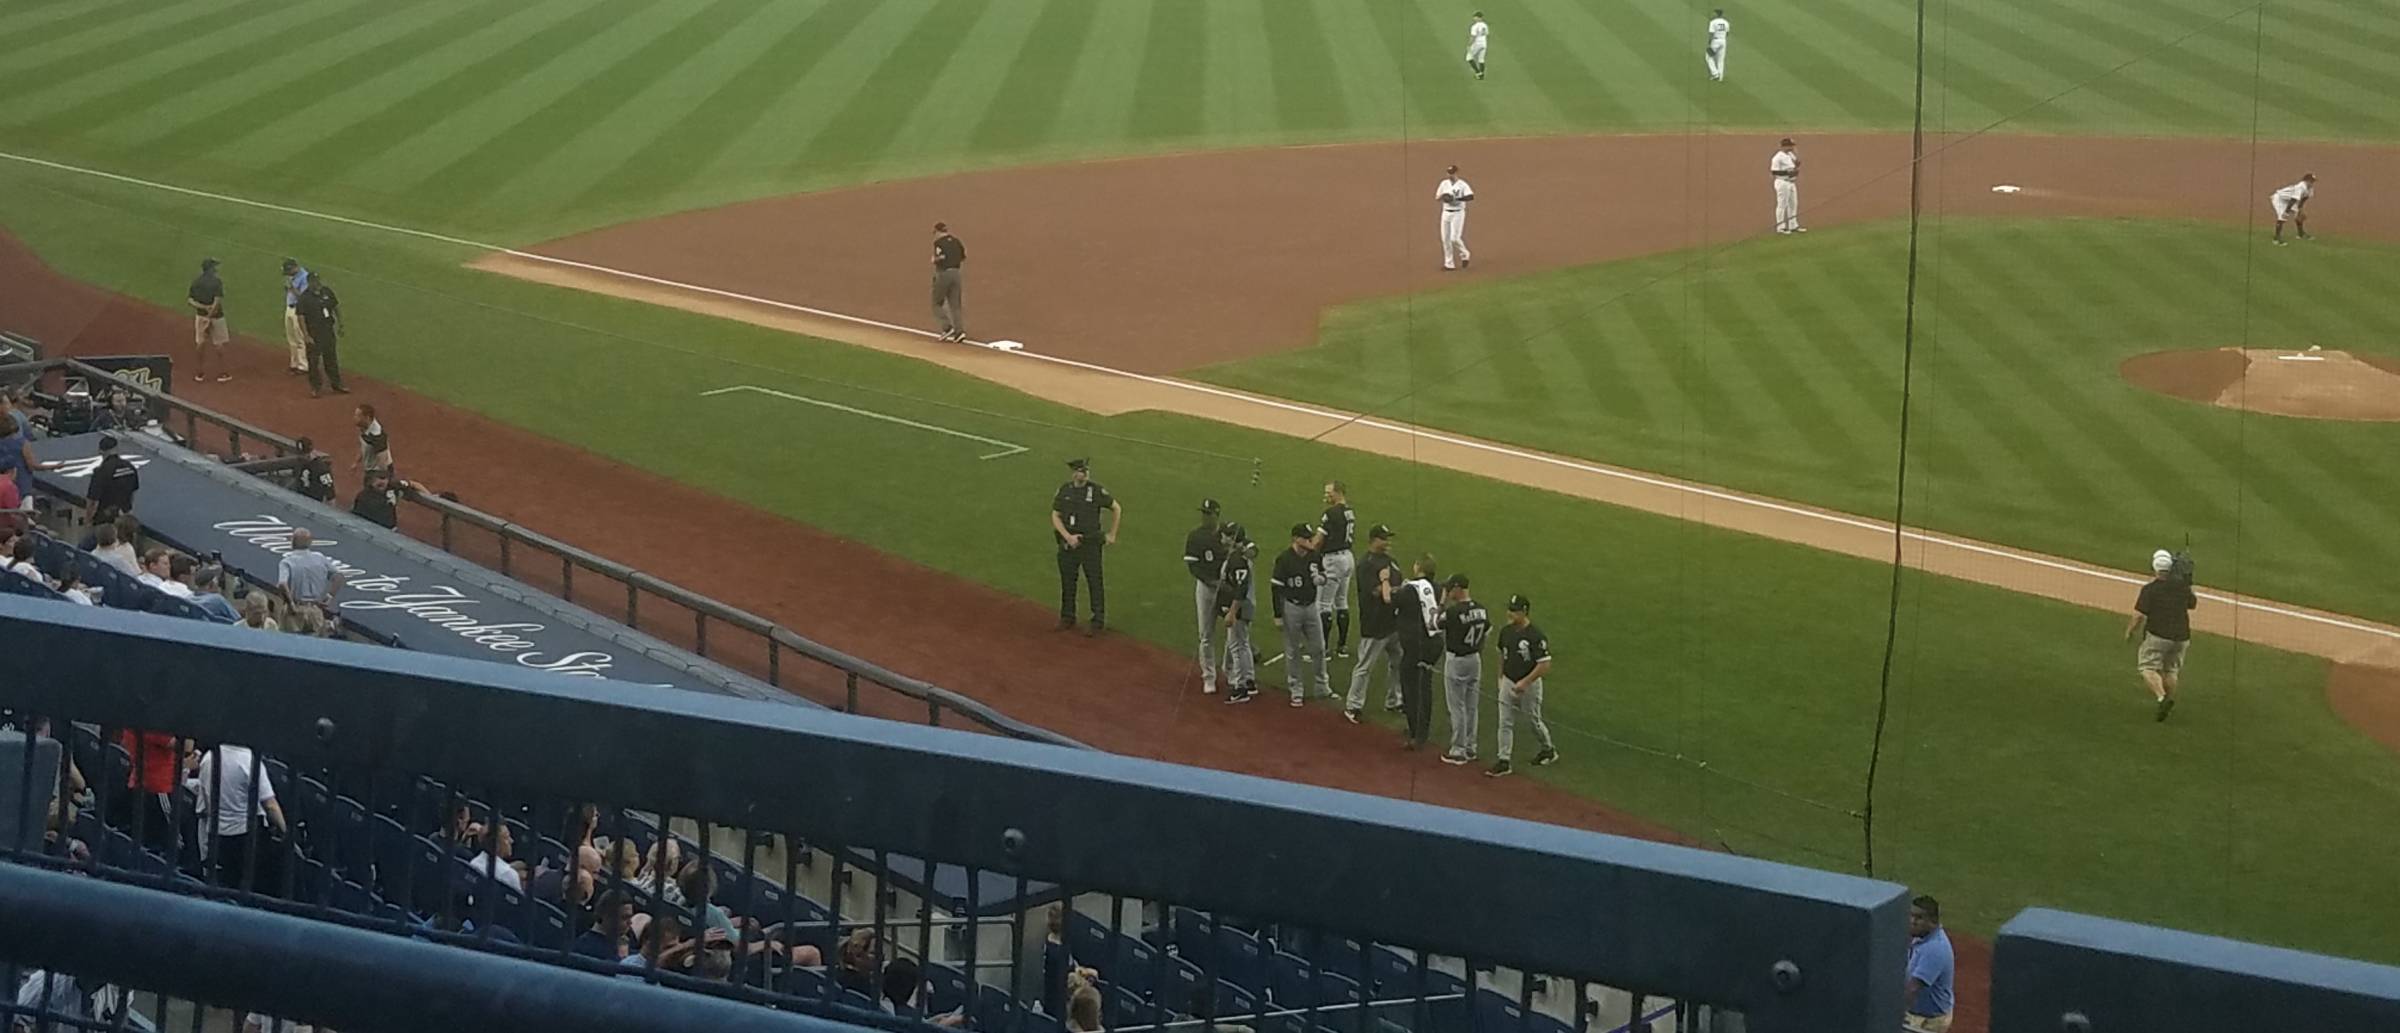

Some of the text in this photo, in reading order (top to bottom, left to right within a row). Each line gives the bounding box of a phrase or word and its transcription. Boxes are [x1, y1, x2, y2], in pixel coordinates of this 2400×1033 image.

[346, 574, 410, 592] to
[1235, 568, 1248, 581] 17
[340, 585, 545, 651] Yankee
[1463, 623, 1485, 648] 47
